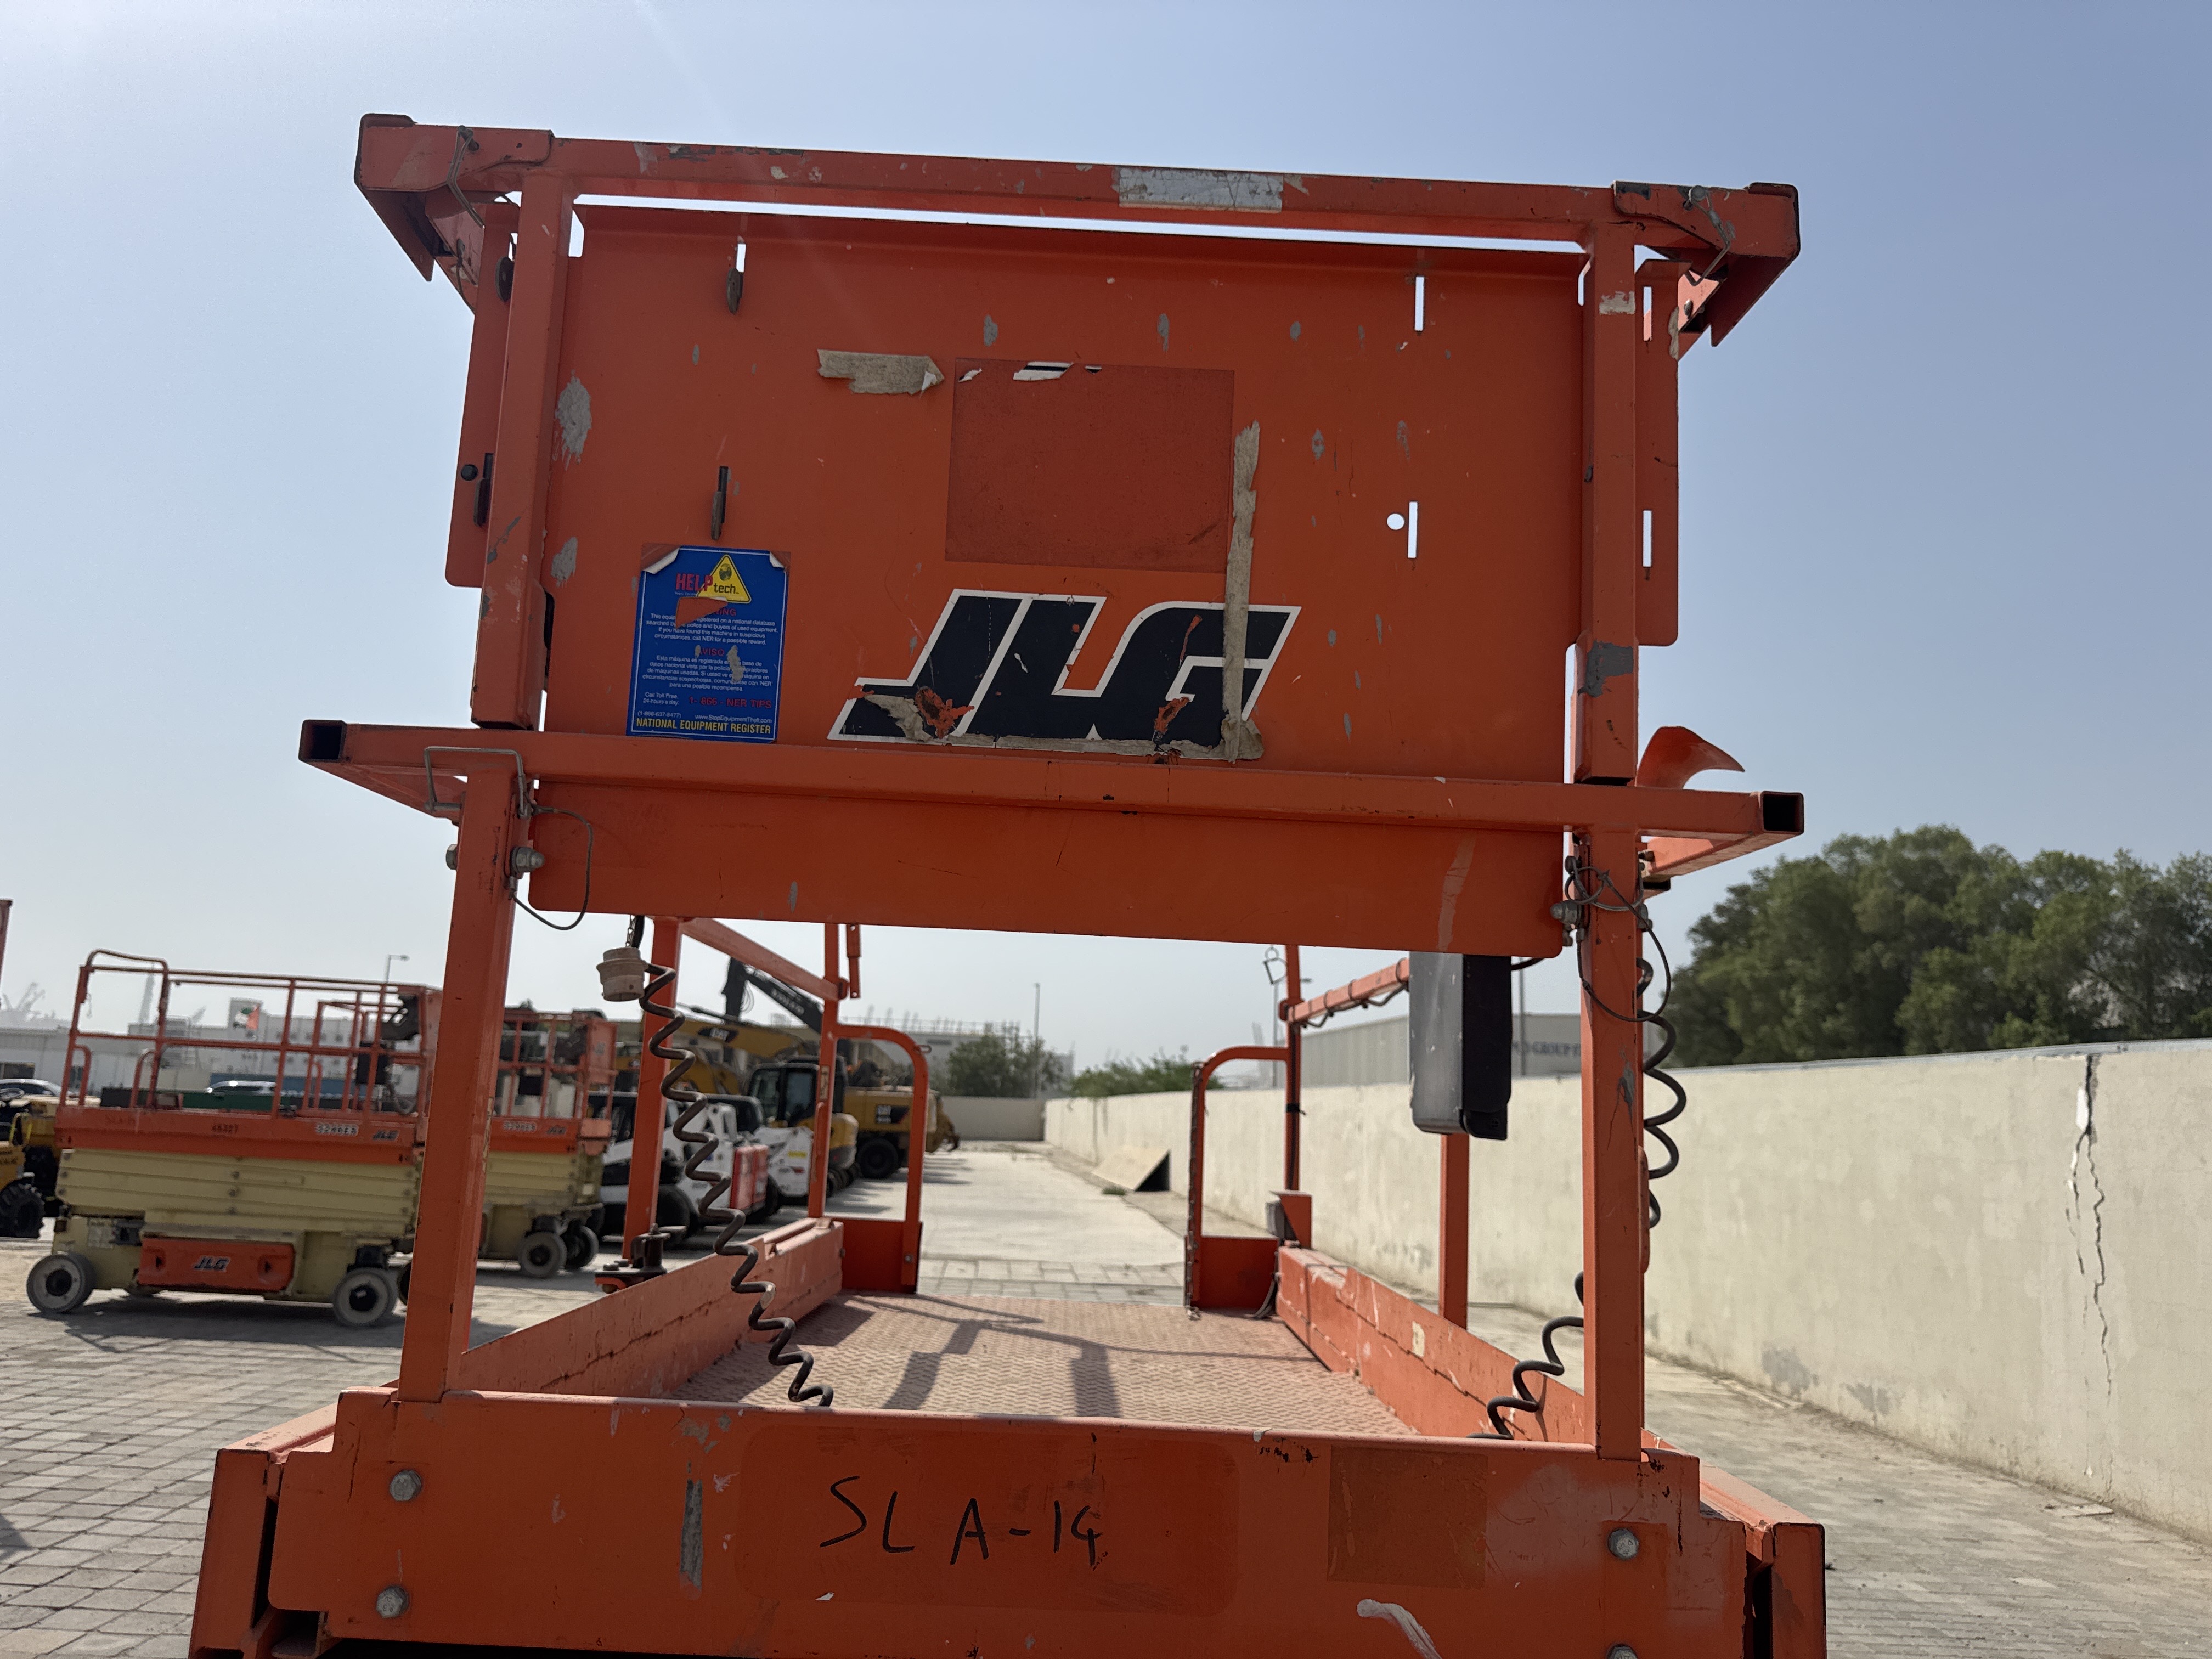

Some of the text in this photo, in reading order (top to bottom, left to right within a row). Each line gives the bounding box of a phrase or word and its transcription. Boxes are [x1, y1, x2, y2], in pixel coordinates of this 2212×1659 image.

[676, 573, 713, 592] HELP
[827, 588, 1301, 759] JLG
[700, 697, 717, 706] 866
[726, 698, 747, 708] NER
[751, 699, 771, 709] TIPS
[636, 718, 771, 735] NATIONAL EQUIPMENT REGISTER
[695, 714, 772, 725] www.StopEquipmentTheft.com
[192, 1255, 231, 1272] JLG
